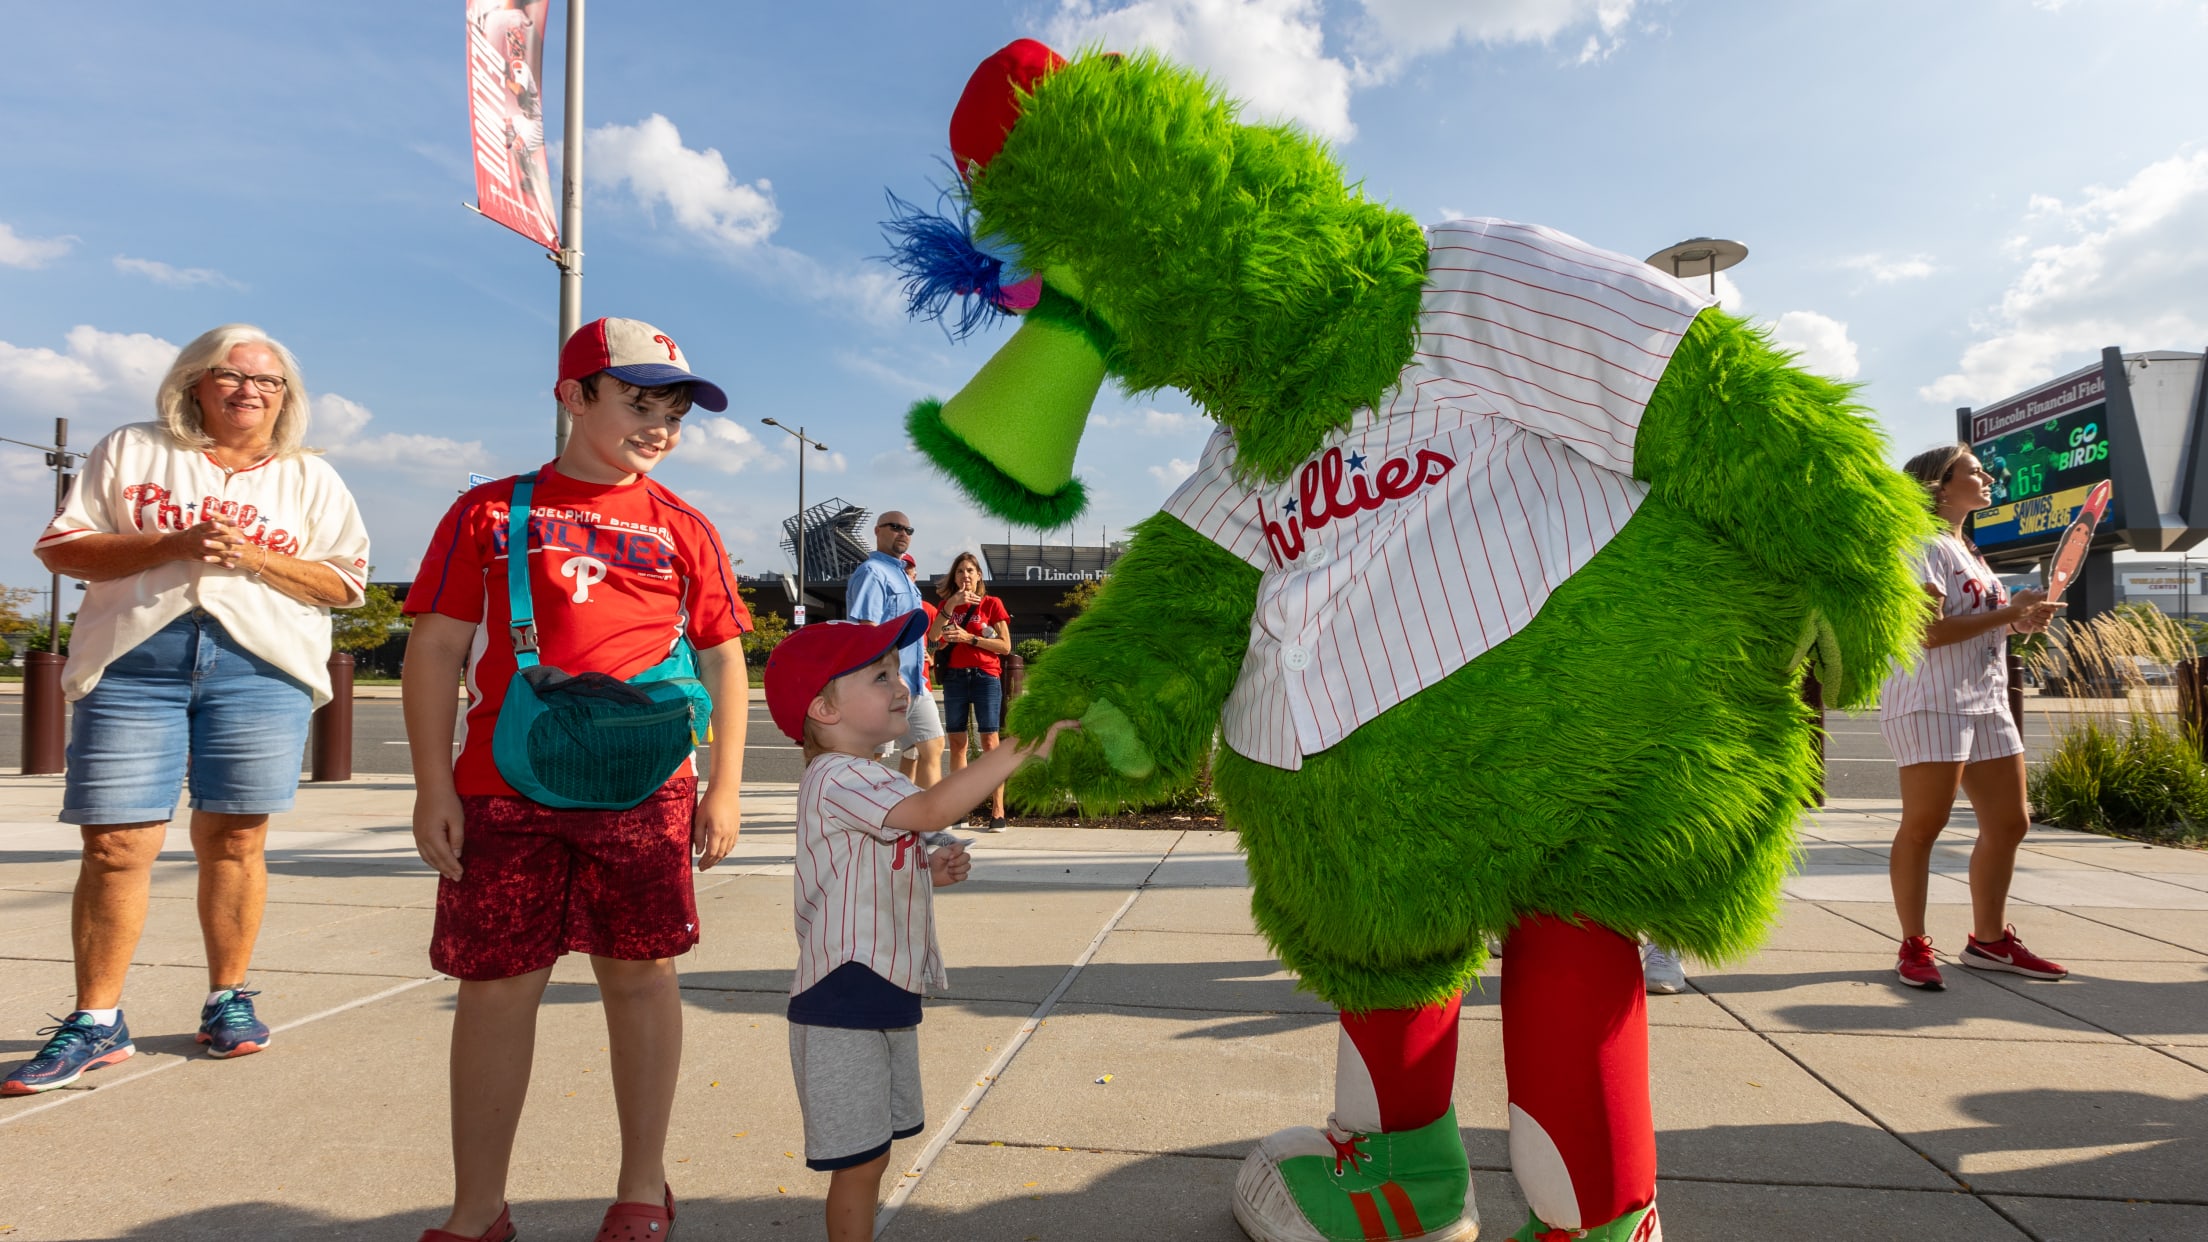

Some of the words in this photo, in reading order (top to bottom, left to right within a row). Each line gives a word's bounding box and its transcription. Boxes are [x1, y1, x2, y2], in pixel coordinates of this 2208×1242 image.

[471, 23, 511, 190] REALMUTO
[1989, 406, 2026, 433] Lincoln
[2026, 385, 2077, 418] Financial
[2069, 422, 2098, 447] GO
[2058, 440, 2109, 471] BIRDS
[2017, 463, 2043, 497] 65
[2013, 495, 2053, 520] SAVINGS
[2018, 513, 2047, 535] SINCE
[2047, 508, 2072, 531] 1936
[560, 556, 607, 604] P
[1044, 568, 1093, 581] Lincoln
